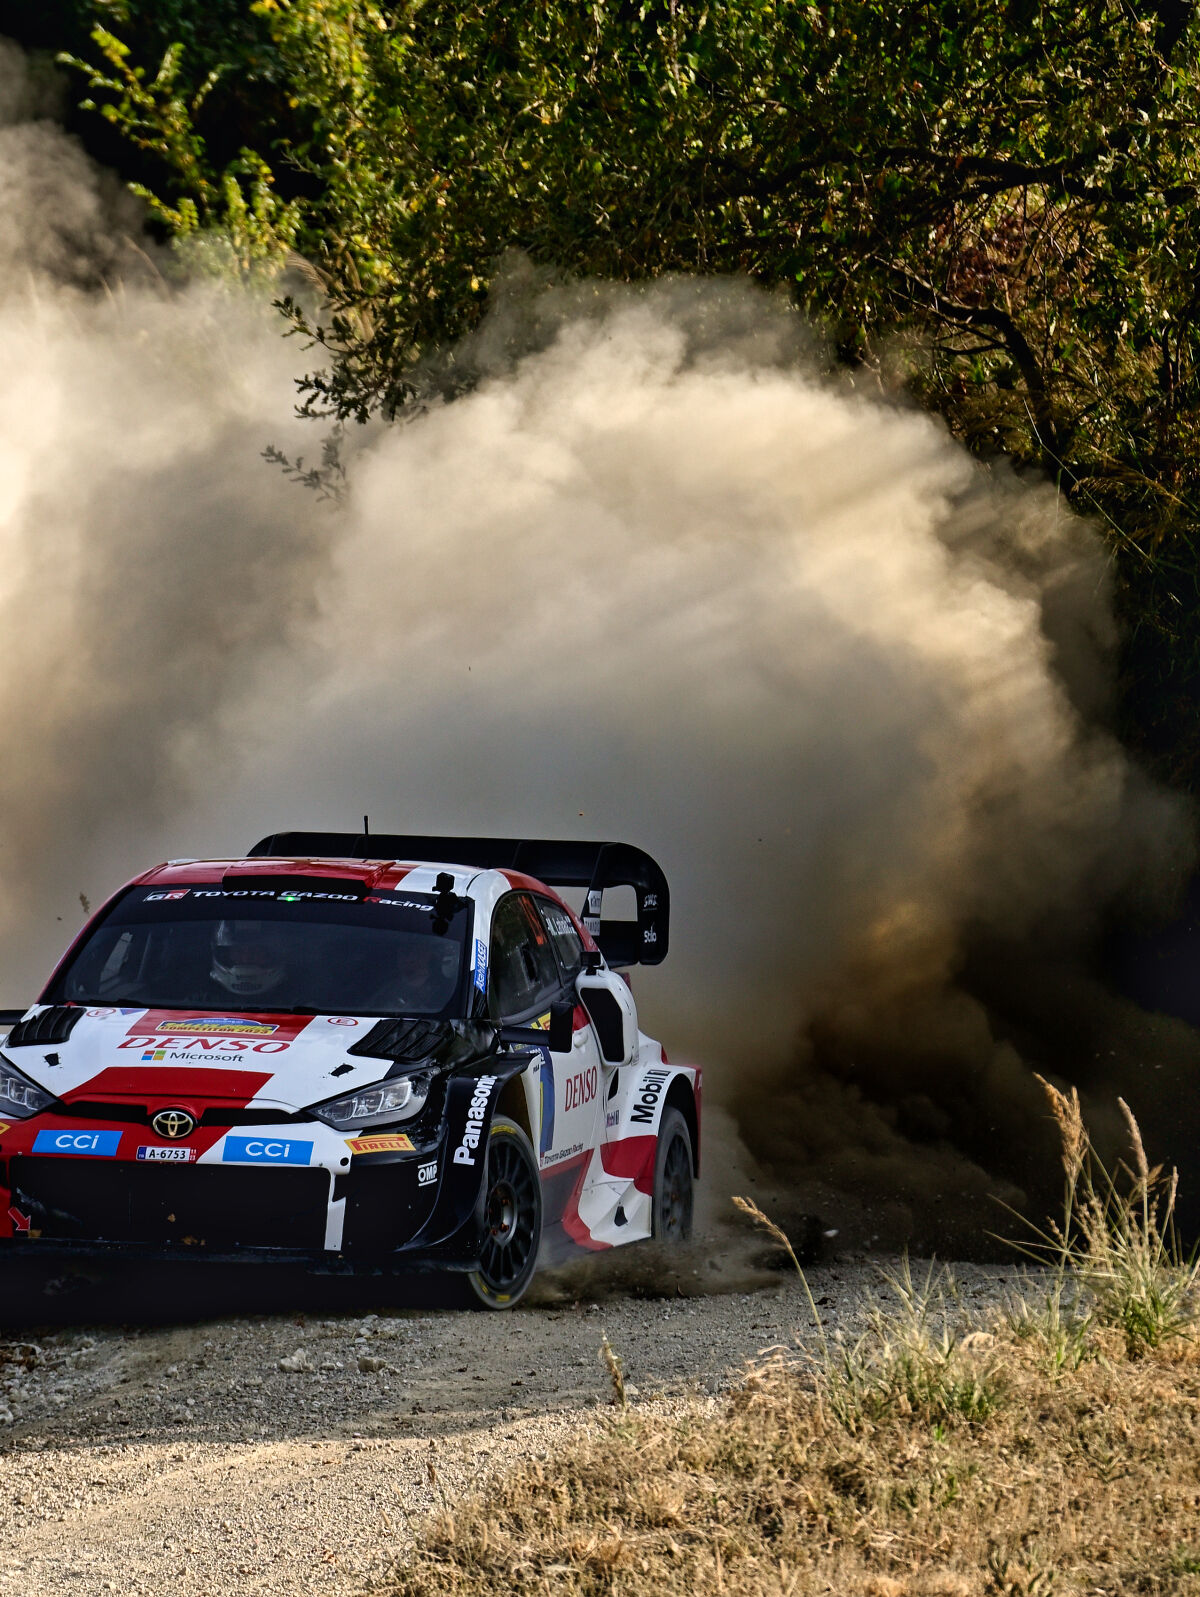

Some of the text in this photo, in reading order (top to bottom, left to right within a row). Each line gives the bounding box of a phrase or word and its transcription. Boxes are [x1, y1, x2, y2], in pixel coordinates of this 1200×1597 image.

[146, 890, 435, 911] GR TOYOTA GAZOO Racing
[117, 1036, 291, 1054] DENSO
[169, 1052, 245, 1063] Microsoft
[564, 1066, 598, 1112] DENSO
[350, 1136, 410, 1151] PIRELLI
[148, 1149, 186, 1160] A-6753
[418, 1164, 438, 1182] OMP
